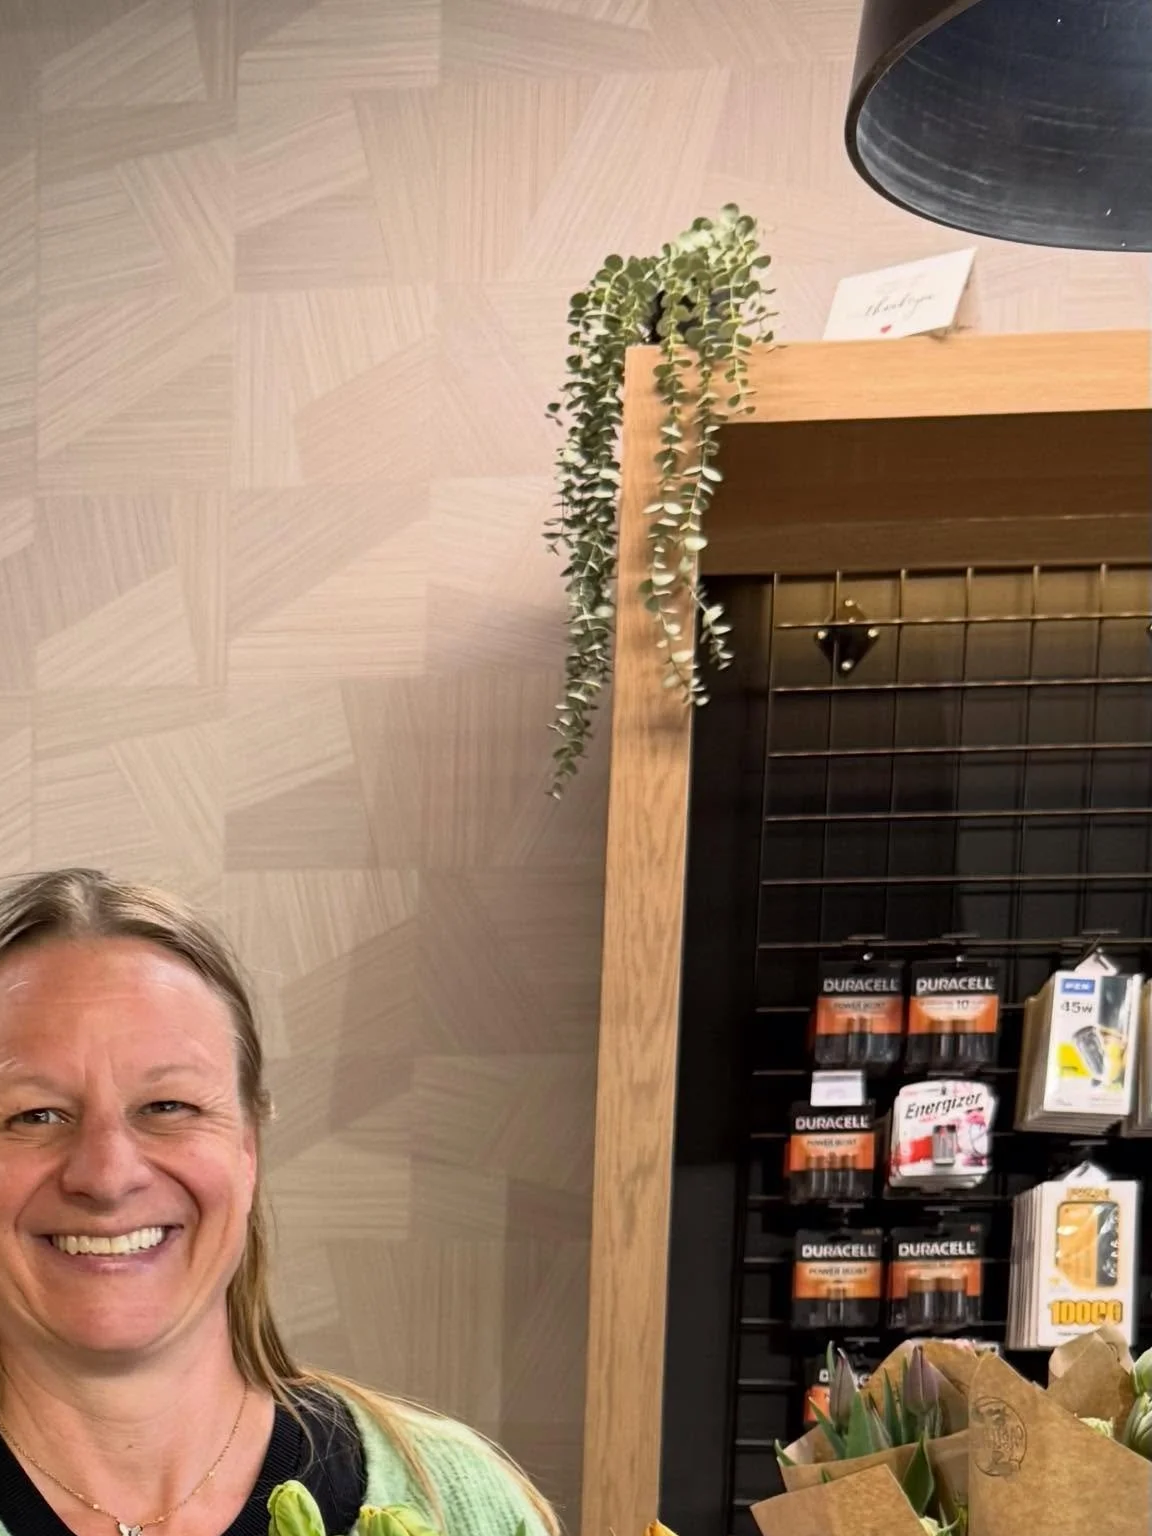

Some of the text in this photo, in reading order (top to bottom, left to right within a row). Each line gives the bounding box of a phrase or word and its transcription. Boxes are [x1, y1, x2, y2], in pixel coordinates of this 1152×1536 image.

[823, 977, 899, 993] DURACELL
[915, 976, 995, 993] DURACELL
[904, 1093, 982, 1120] Energizer
[795, 1115, 870, 1131] DURACELL
[802, 1243, 877, 1259] DURACELL
[898, 1240, 977, 1257] DURACELL
